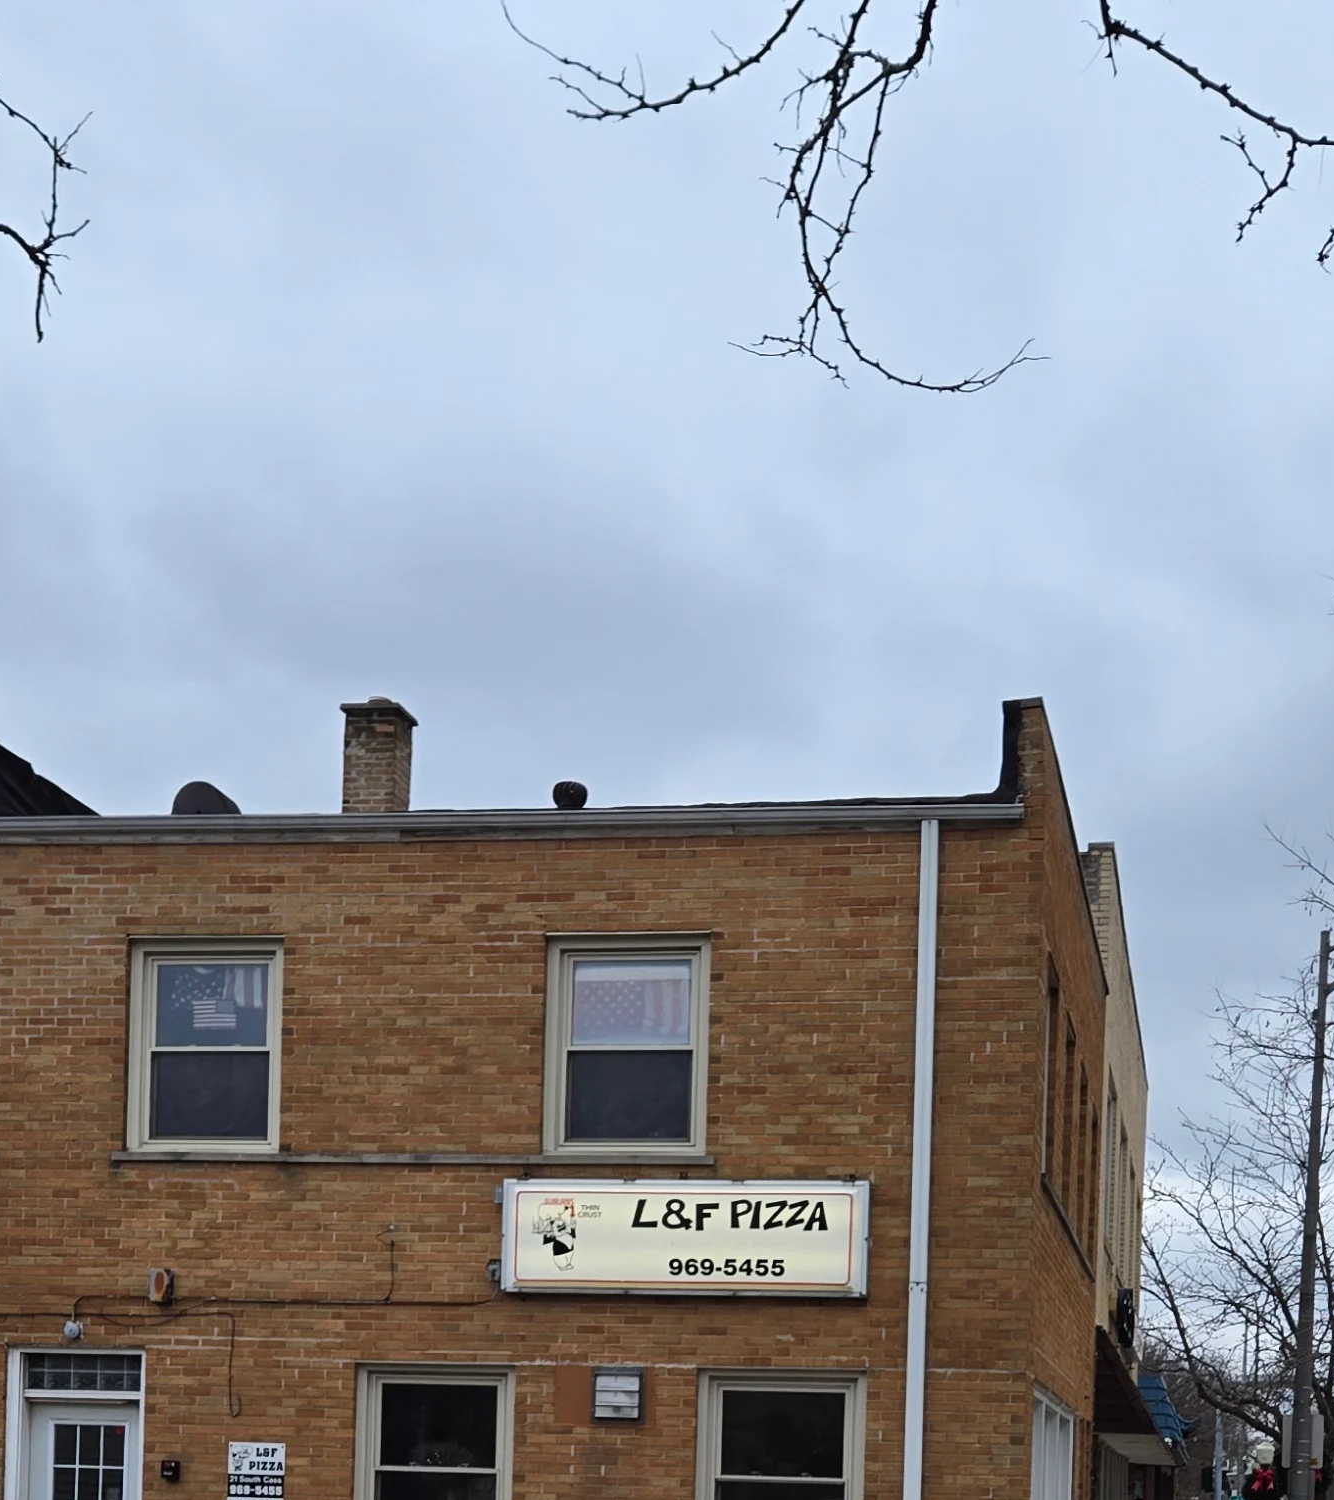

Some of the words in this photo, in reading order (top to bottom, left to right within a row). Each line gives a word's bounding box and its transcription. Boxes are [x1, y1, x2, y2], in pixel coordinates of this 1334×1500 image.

[578, 1211, 603, 1219] CRUST
[631, 1198, 720, 1231] L&F
[730, 1199, 828, 1231] PIZZA
[668, 1258, 785, 1277] 969-5455
[255, 1447, 278, 1458] L&F
[249, 1461, 284, 1472] PIZZA
[229, 1475, 238, 1483] 21
[239, 1475, 261, 1483] South
[229, 1484, 283, 1496] 969-5455
